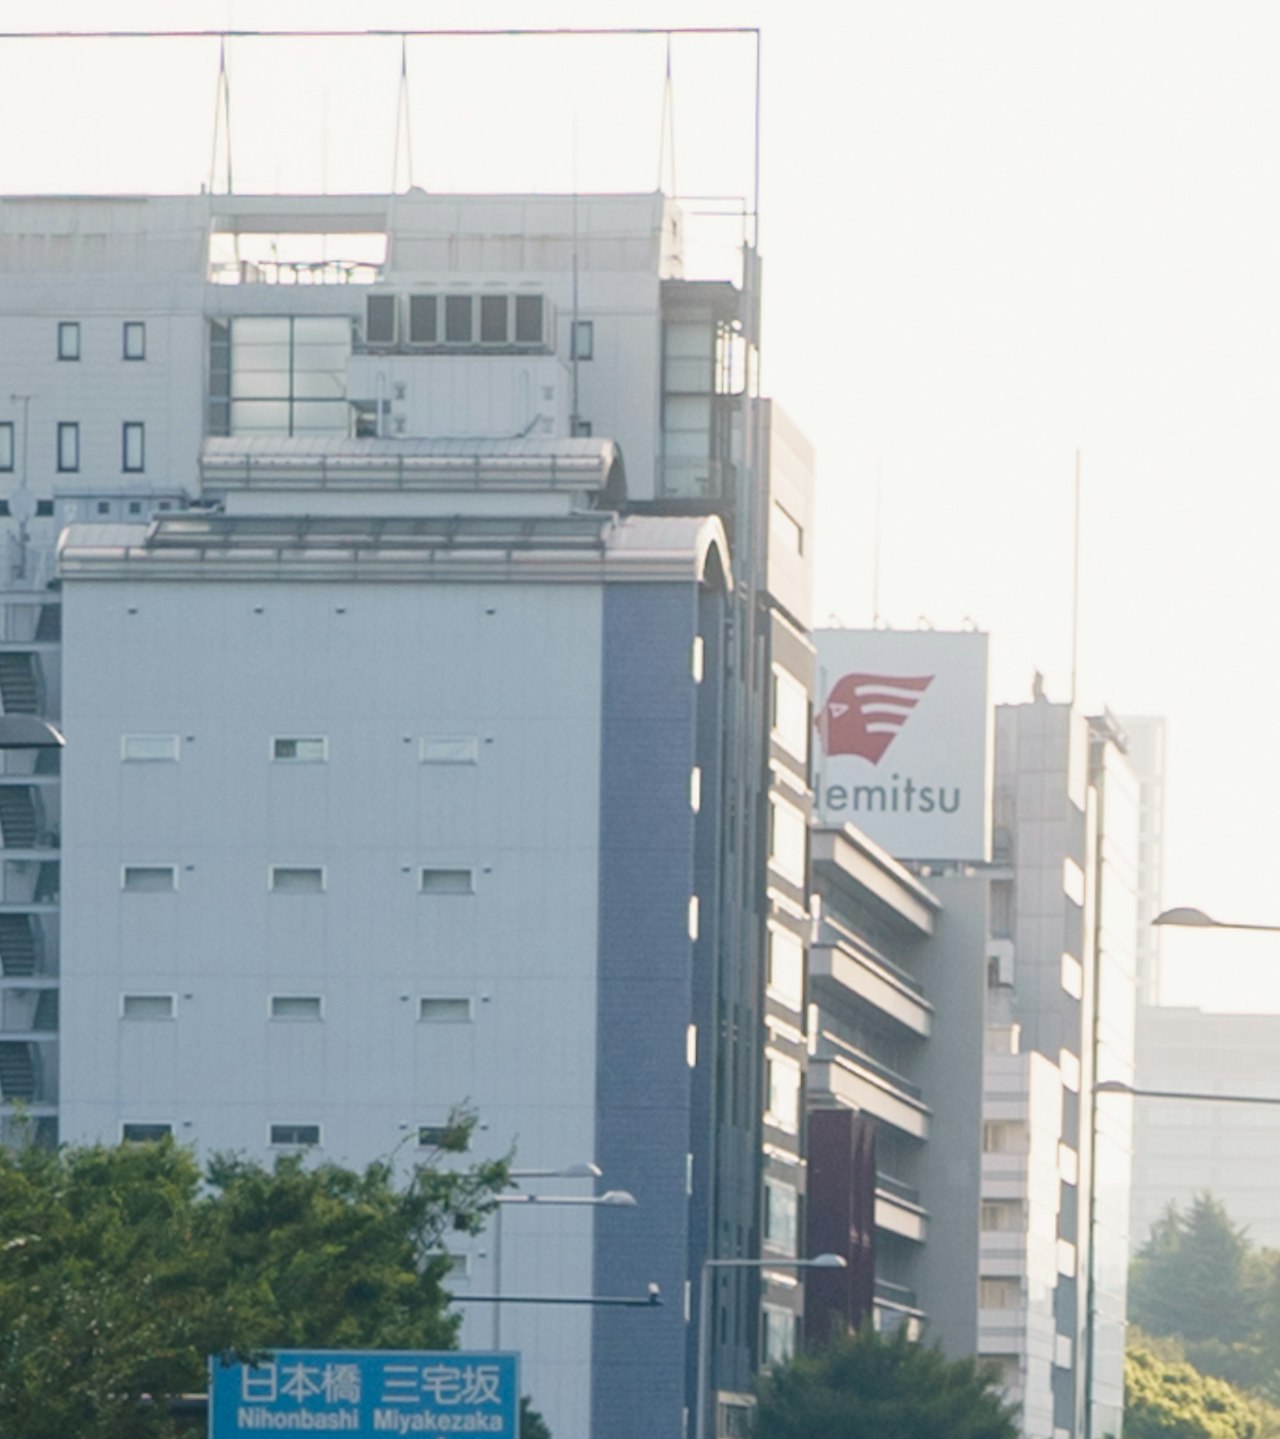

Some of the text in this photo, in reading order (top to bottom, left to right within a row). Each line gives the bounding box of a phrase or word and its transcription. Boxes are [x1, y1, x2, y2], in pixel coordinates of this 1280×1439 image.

[242, 1362, 502, 1405] 日本橋 三宅坂
[238, 1408, 503, 1435] Nihonbashi Miyakezaka
